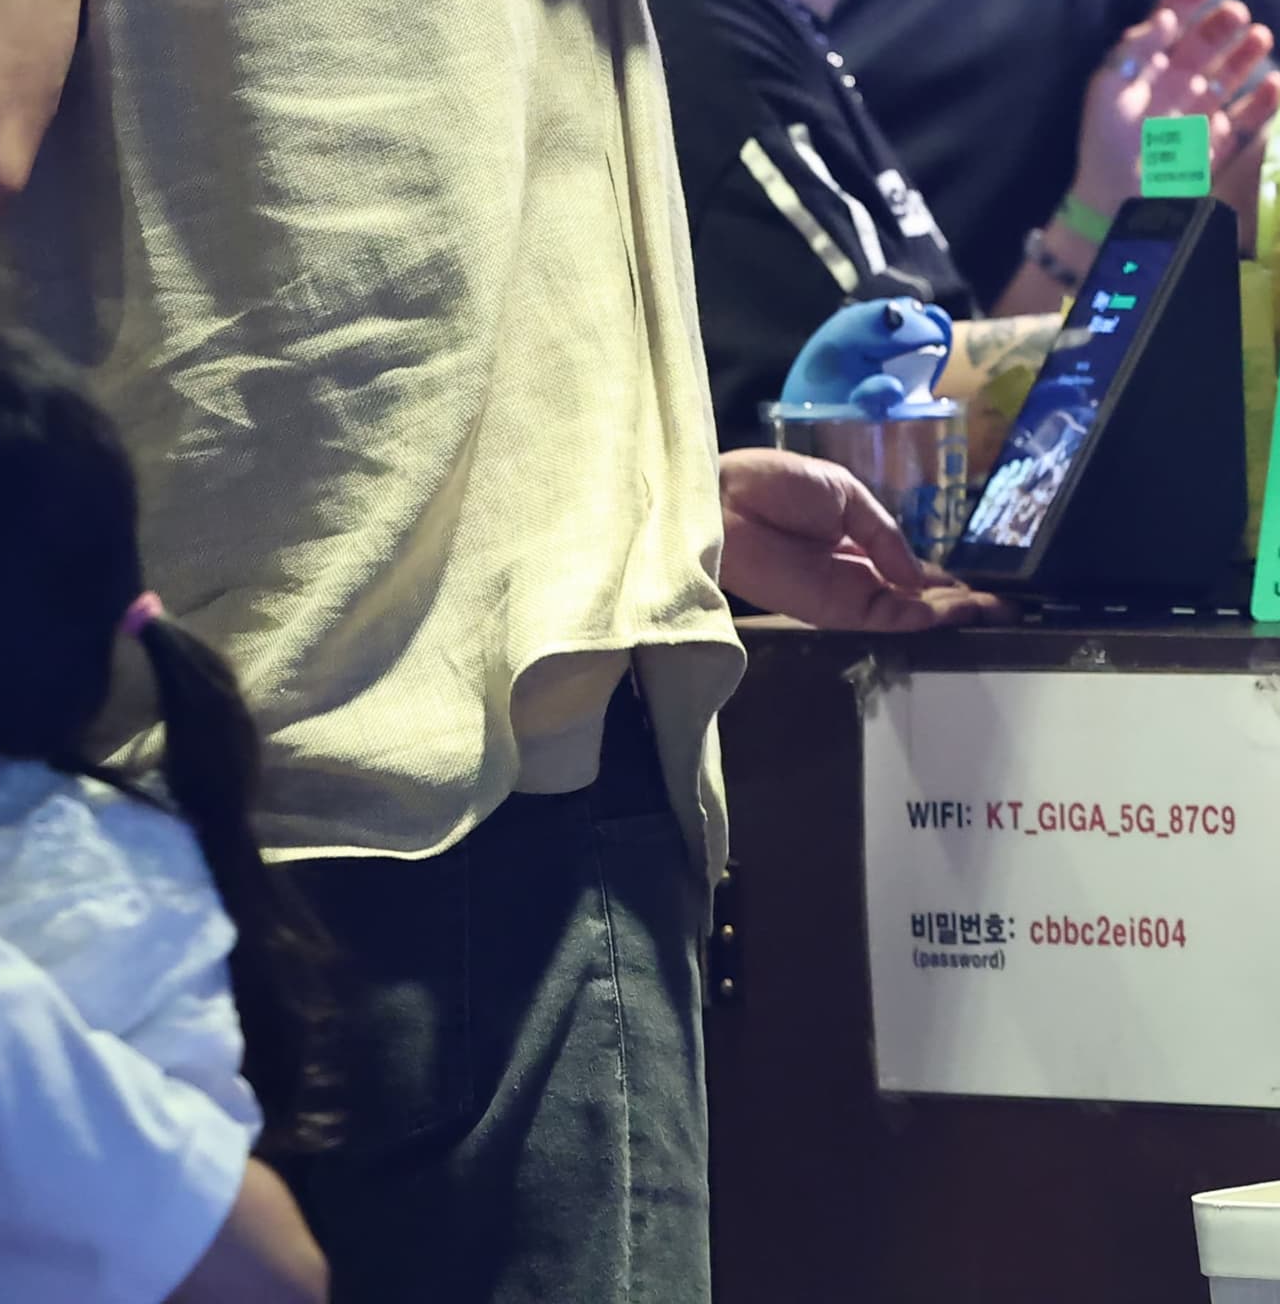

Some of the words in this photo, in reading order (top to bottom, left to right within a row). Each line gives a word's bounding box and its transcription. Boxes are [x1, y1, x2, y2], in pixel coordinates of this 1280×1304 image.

[906, 801, 972, 829] WIFI:
[986, 801, 1236, 839] KT_GIGA_5G_87C9
[911, 912, 1015, 945] 비밀번호:
[1030, 914, 1187, 948] cbbc2ei604
[913, 948, 1005, 971] (password)
